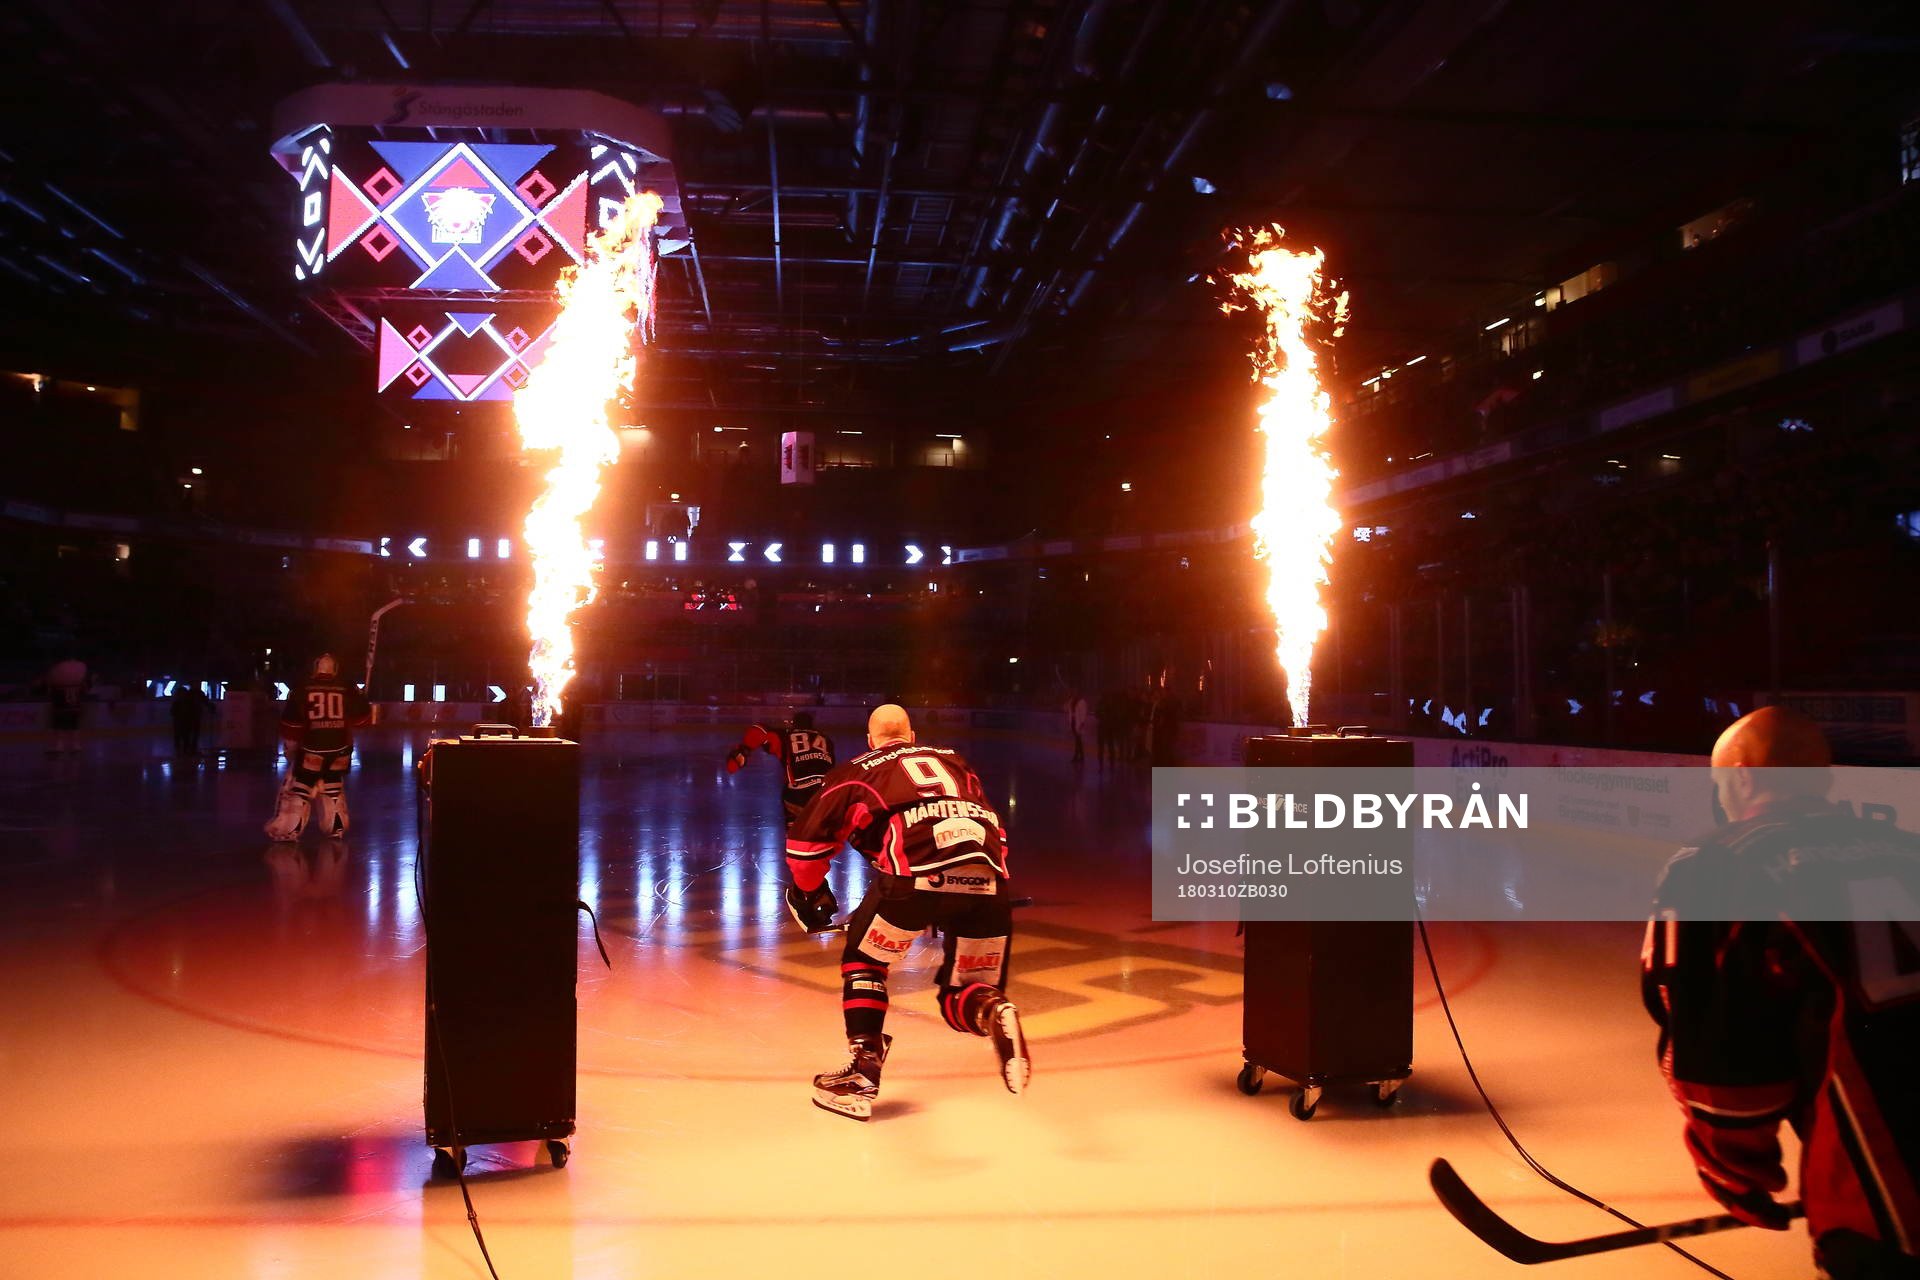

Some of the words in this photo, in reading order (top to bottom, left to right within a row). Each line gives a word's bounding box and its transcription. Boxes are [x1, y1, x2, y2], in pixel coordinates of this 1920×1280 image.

[308, 692, 344, 720] 30
[790, 732, 827, 754] 84
[901, 755, 960, 798] 9
[867, 928, 912, 951] MAXI
[958, 954, 1001, 969] MAXI
